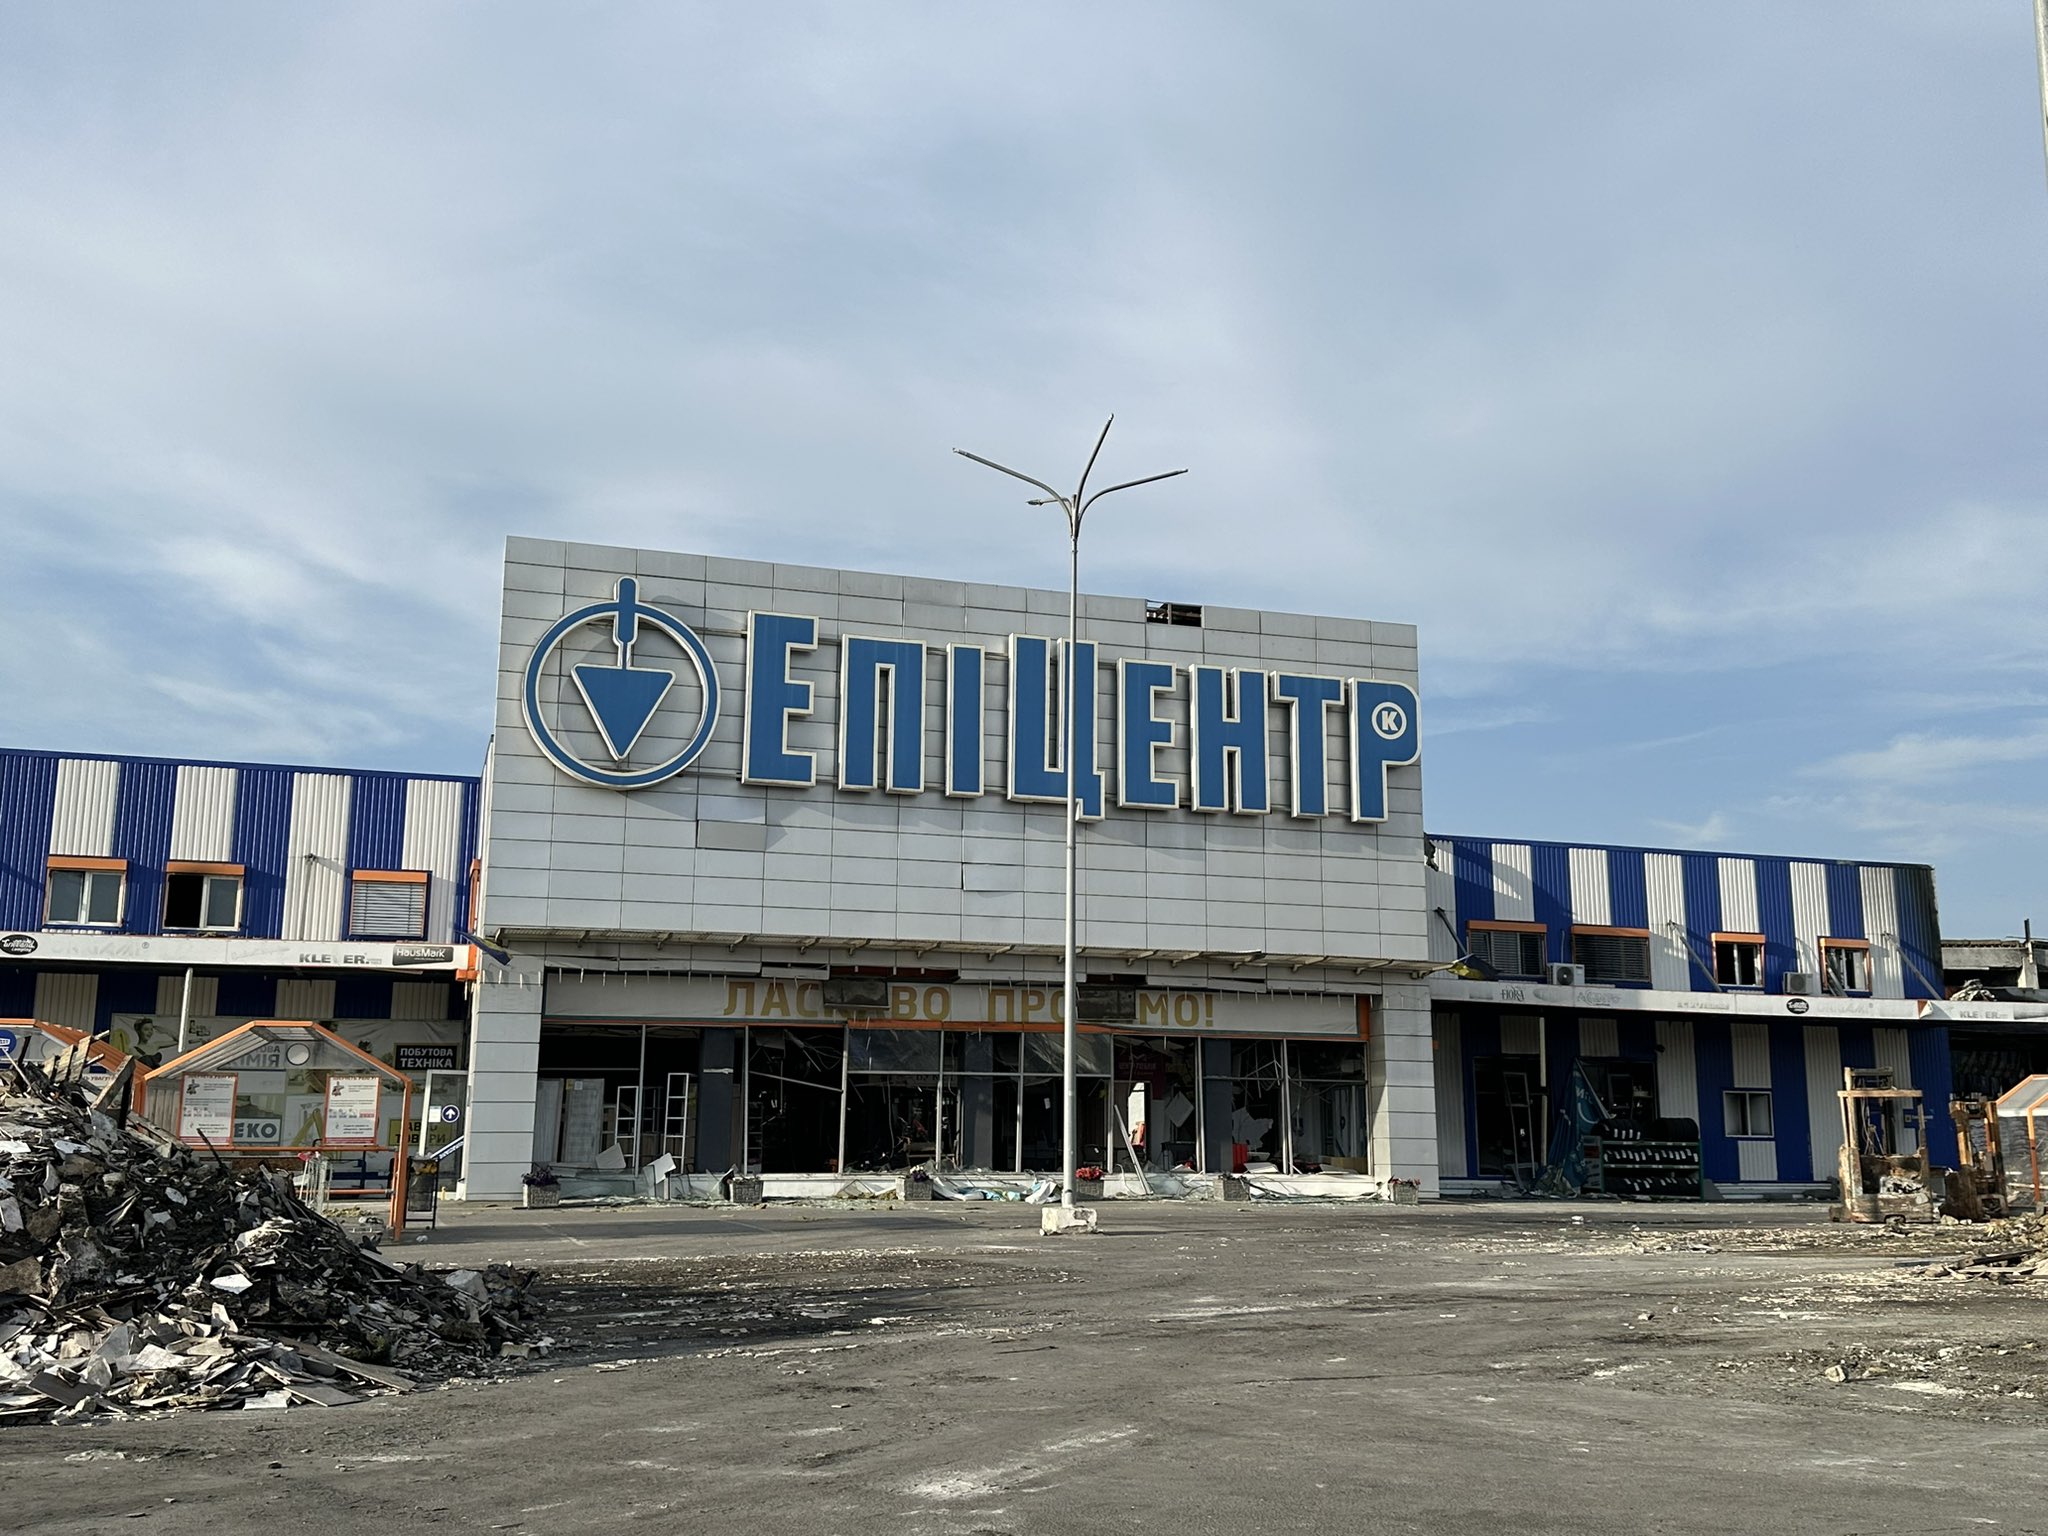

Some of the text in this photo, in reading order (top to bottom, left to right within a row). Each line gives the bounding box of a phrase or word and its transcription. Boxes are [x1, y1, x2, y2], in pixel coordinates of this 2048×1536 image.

[741, 610, 1421, 823] ЕПІЦЕНТР
[723, 981, 1214, 1027] ЛАСВО ПРОМО!
[400, 1048, 453, 1056] ПОБУТОВА
[400, 1058, 453, 1068] ТЕХНІКА
